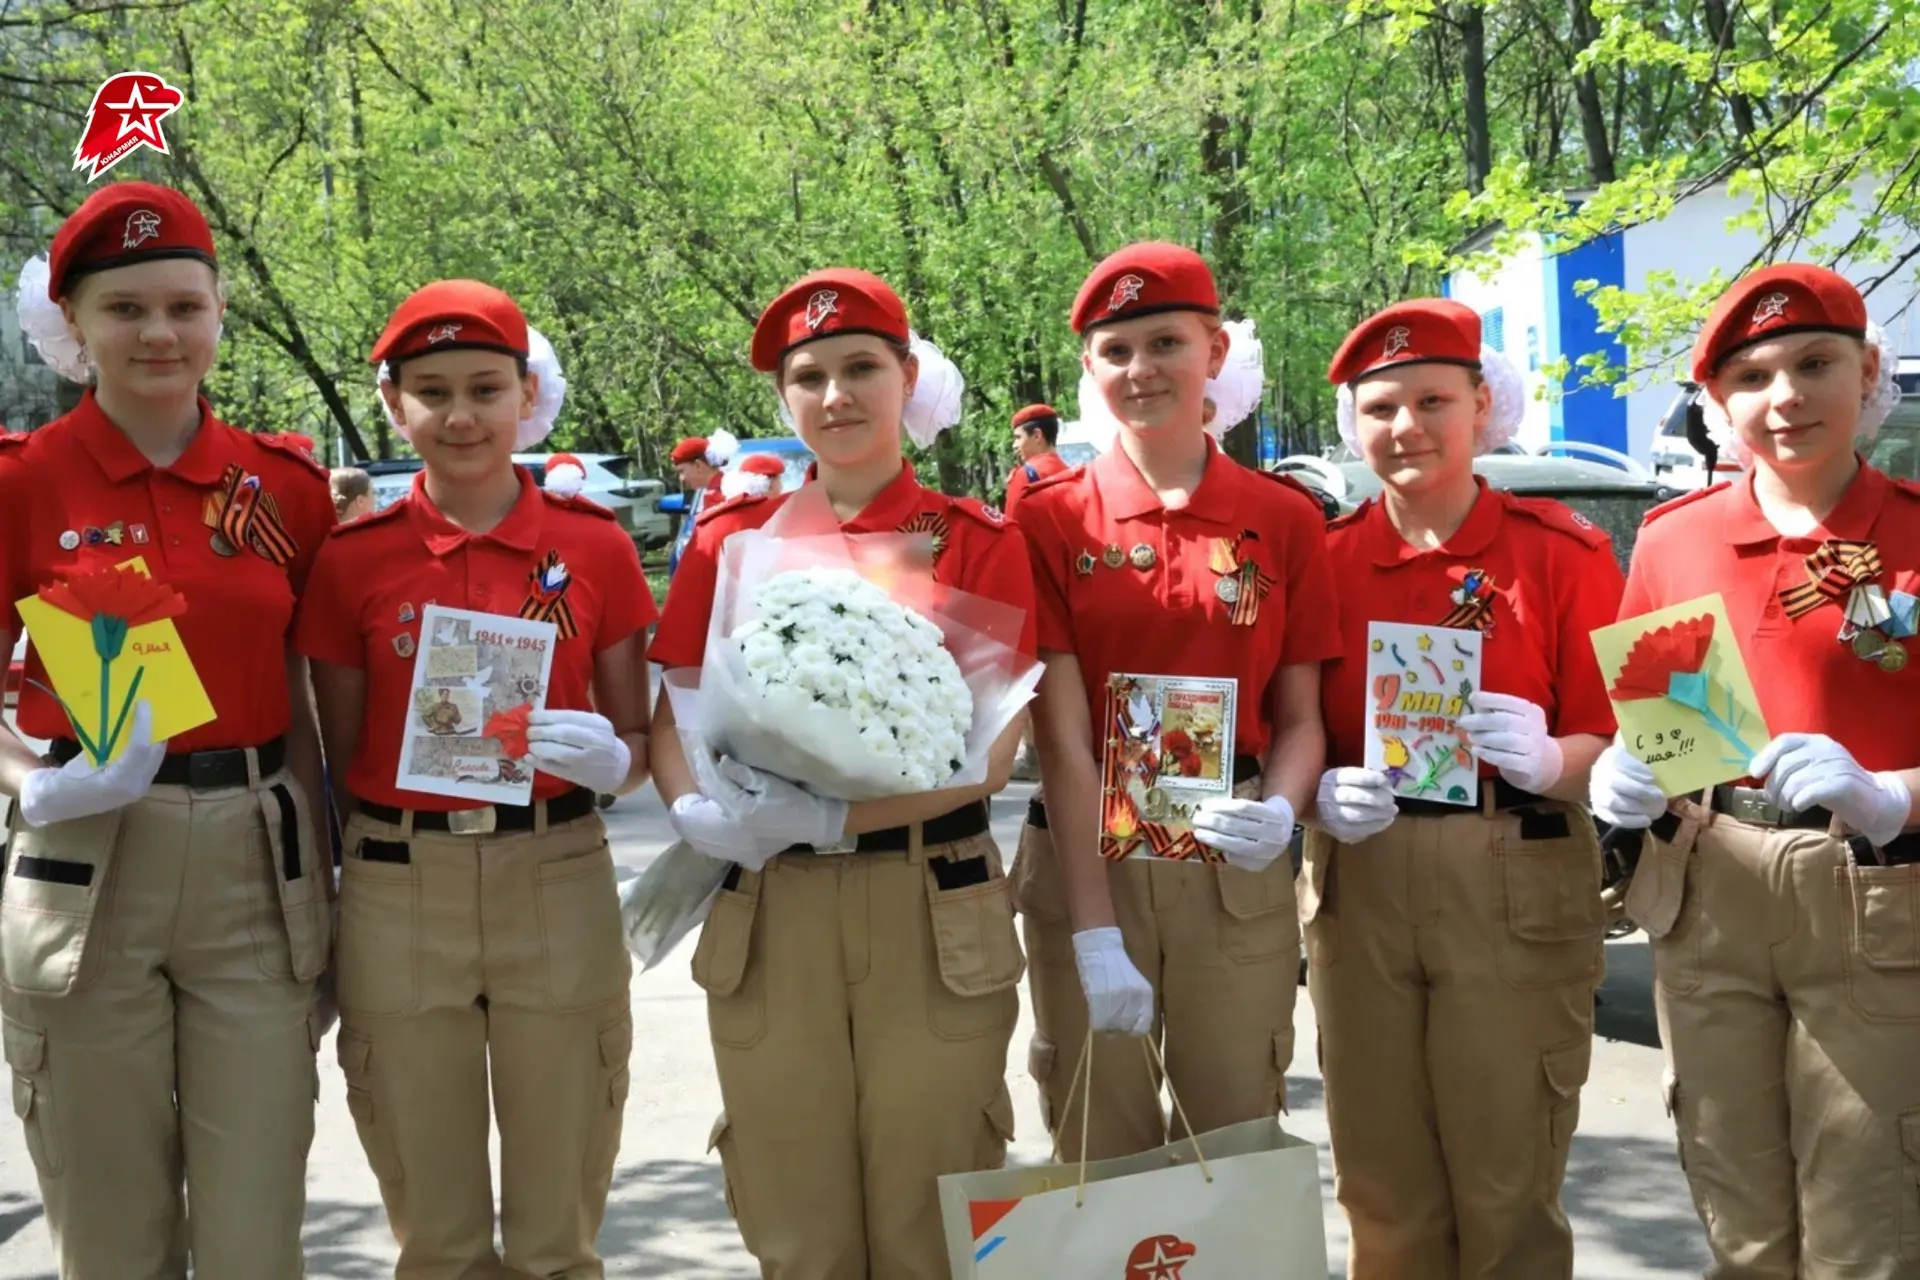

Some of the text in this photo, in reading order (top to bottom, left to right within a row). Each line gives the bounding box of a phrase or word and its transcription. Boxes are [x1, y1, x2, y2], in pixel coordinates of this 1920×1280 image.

[474, 630, 547, 652] 1941 1945
[1373, 674, 1401, 711] 9
[1636, 732, 1664, 750] С 9
